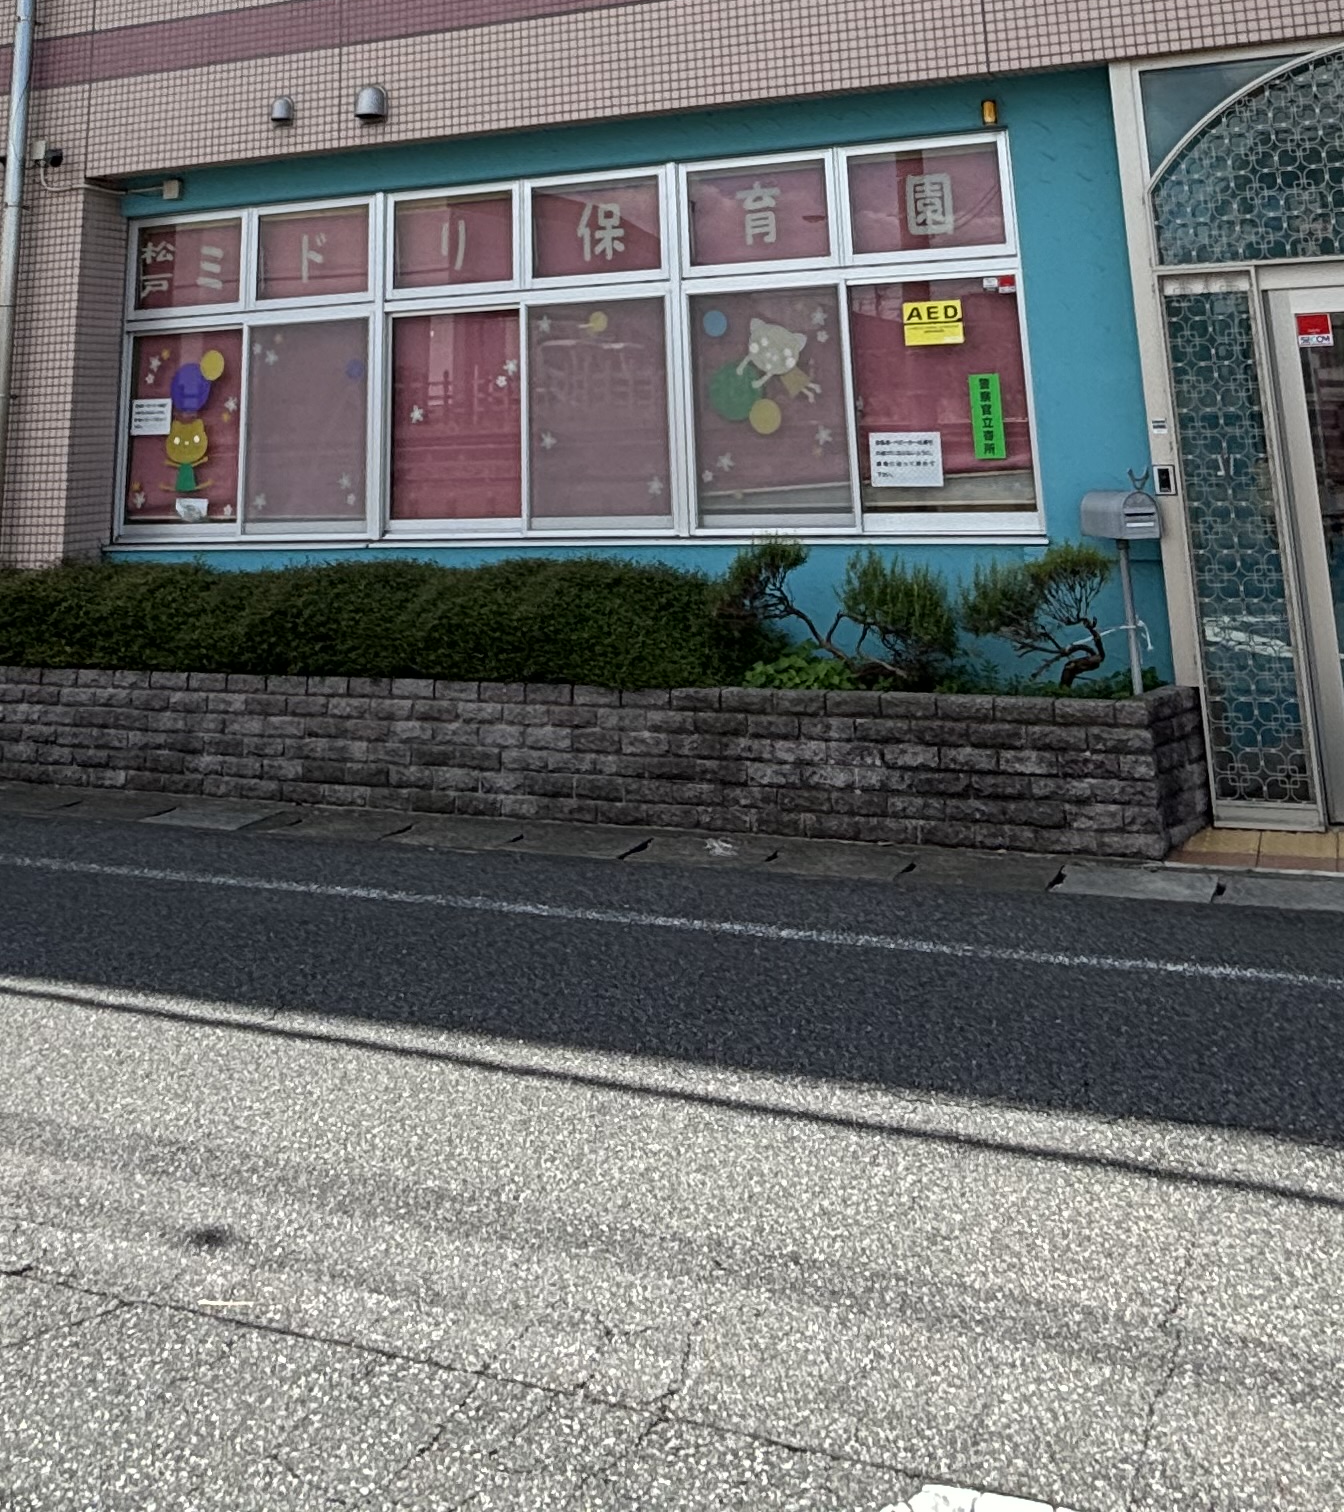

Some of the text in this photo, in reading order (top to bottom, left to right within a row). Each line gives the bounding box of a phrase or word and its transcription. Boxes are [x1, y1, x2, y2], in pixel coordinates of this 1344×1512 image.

[196, 172, 954, 290] ミドリ保育園
[906, 304, 959, 322] AED
